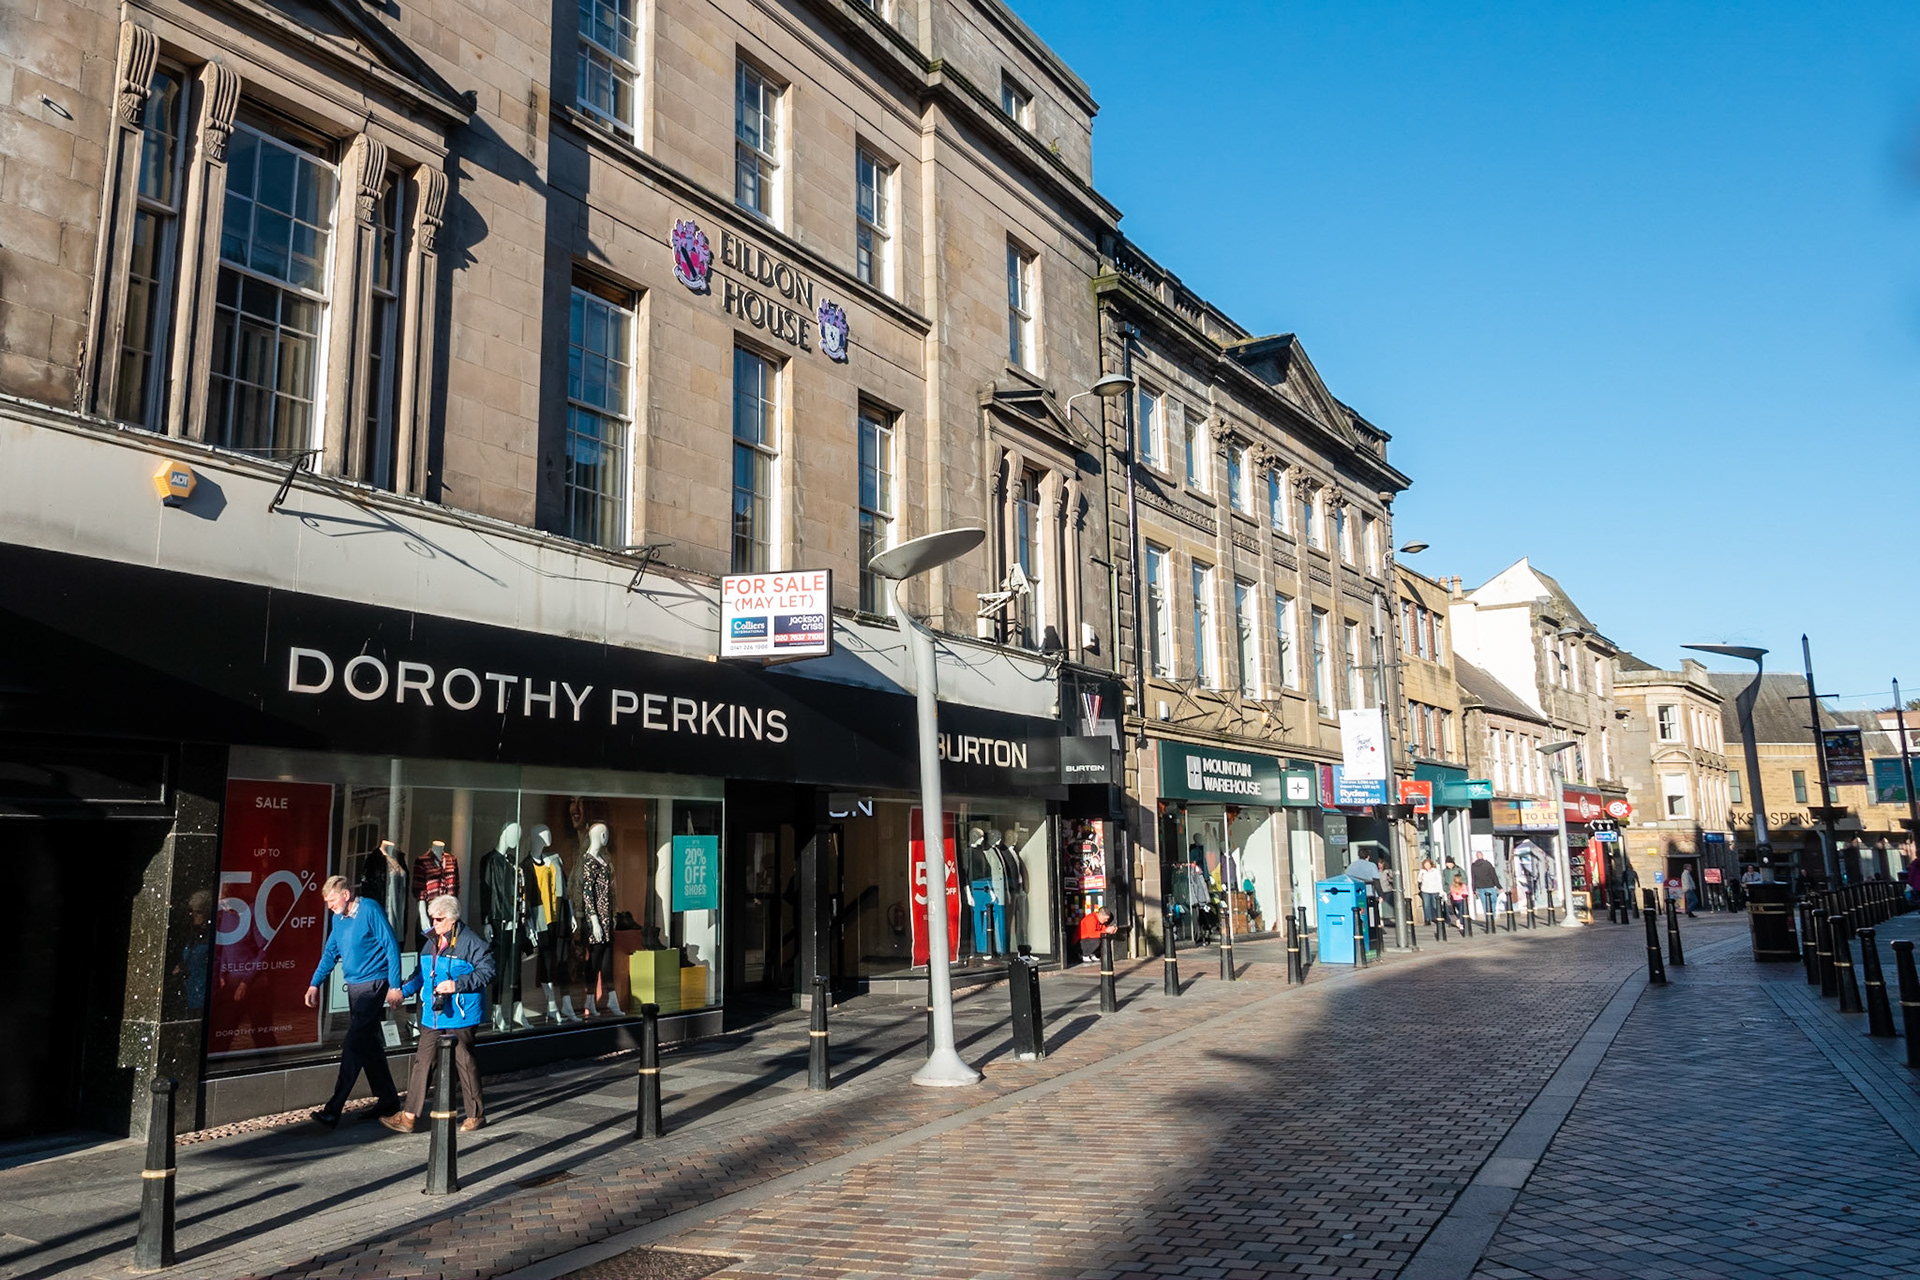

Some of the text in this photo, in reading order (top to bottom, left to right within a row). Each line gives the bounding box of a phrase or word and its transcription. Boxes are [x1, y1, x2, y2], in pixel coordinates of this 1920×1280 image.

[719, 229, 813, 310] EILDON
[722, 277, 812, 352] HOUSE
[172, 474, 189, 485] ADT
[724, 575, 824, 595] FOR SALE
[735, 594, 814, 612] (MAY LET)
[734, 621, 765, 630] Colliers
[788, 614, 824, 626] jackson
[801, 622, 824, 631] criss
[288, 646, 789, 744] DOROTHY PERKINS
[1065, 764, 1105, 773] BURTON
[1203, 757, 1252, 777] MOUNTAIN
[1203, 776, 1262, 796] WAREHOUSE
[1340, 789, 1369, 798] Ryden
[255, 797, 289, 809] SALE
[253, 848, 281, 857] UP TO
[684, 847, 707, 866] 20%
[684, 866, 707, 884] OFF
[684, 883, 707, 896] SHOES
[216, 870, 317, 950] 50%
[290, 916, 316, 929] OFF
[221, 960, 296, 973] SELECTED LINES
[215, 1024, 293, 1038] DOROTHY PERKINS
